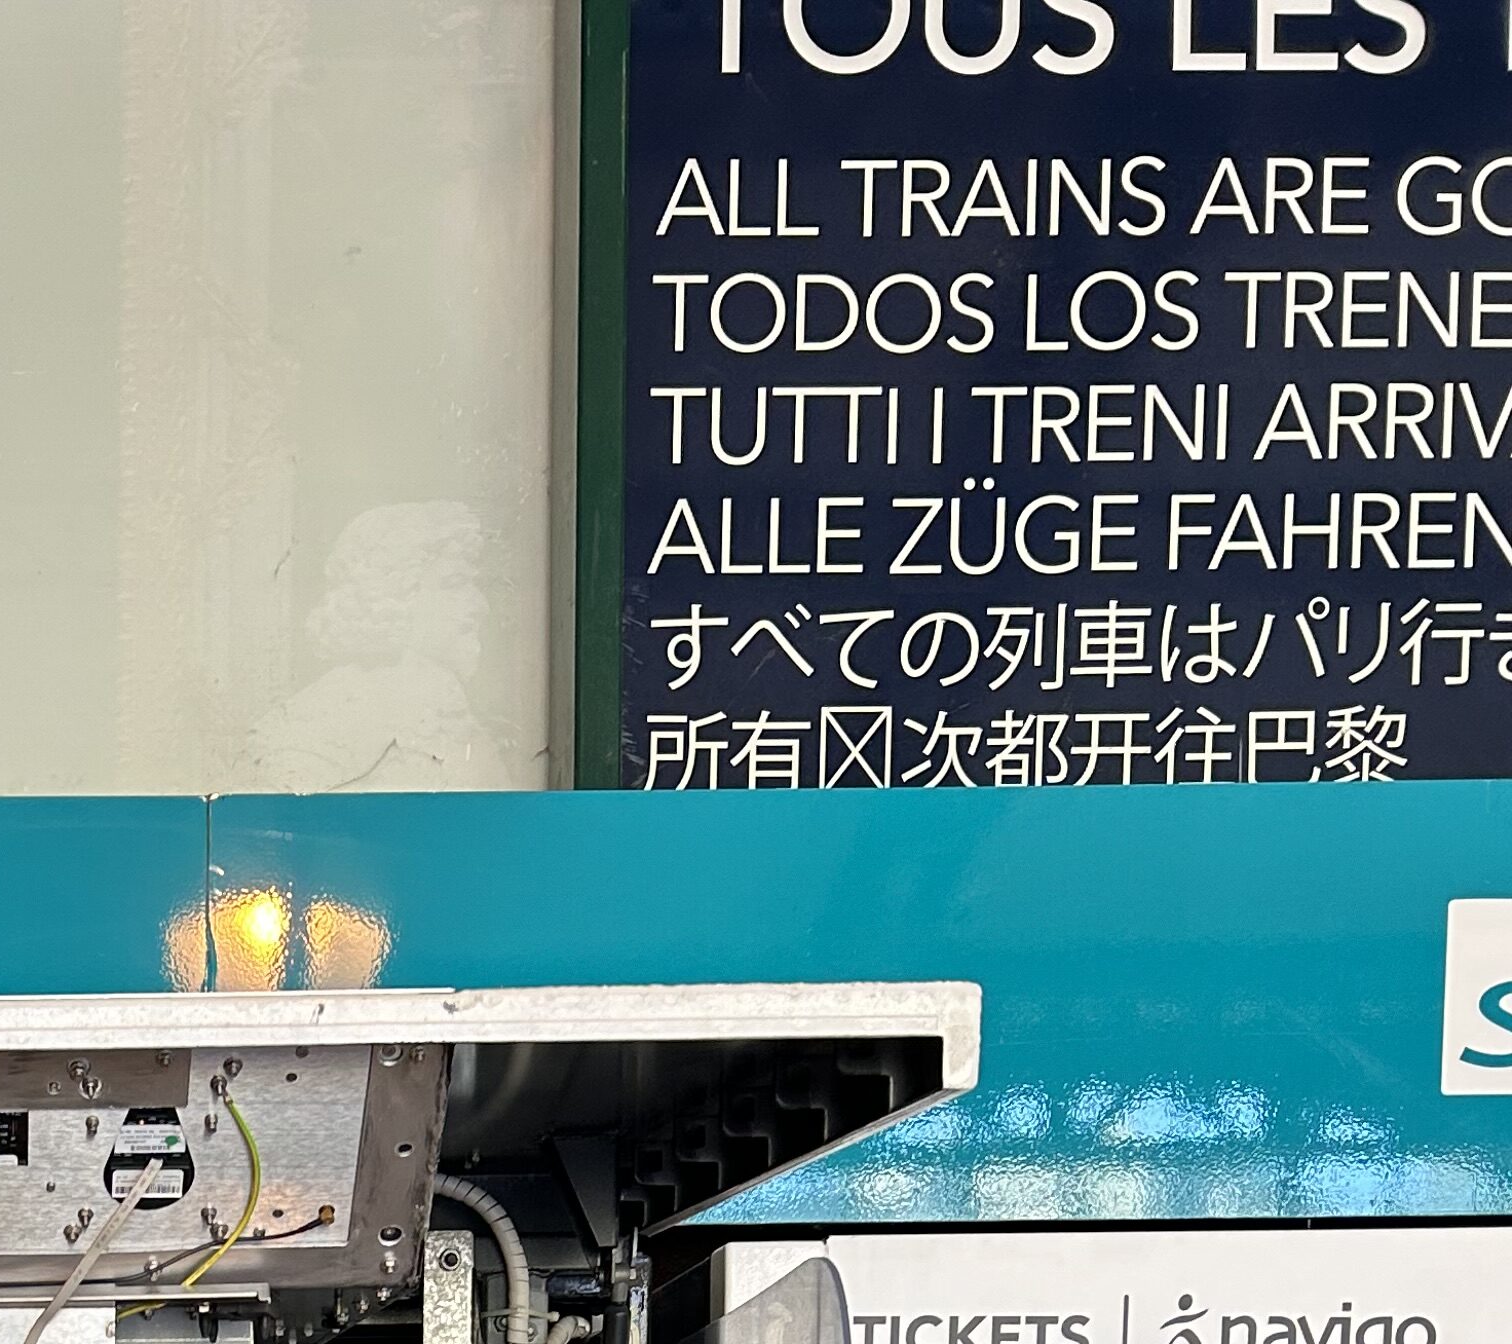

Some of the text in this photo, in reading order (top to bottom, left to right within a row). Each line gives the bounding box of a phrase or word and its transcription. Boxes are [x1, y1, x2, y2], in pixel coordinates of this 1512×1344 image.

[656, 158, 818, 236] ALL
[841, 156, 1166, 236] TRAINS
[1190, 157, 1369, 234] ARE
[653, 270, 1512, 353] TODOS LOS TRENE
[650, 382, 1512, 465] TUTTI I TRENI ARRIV
[647, 476, 1512, 576] ALLE ZÜGE FAHREN
